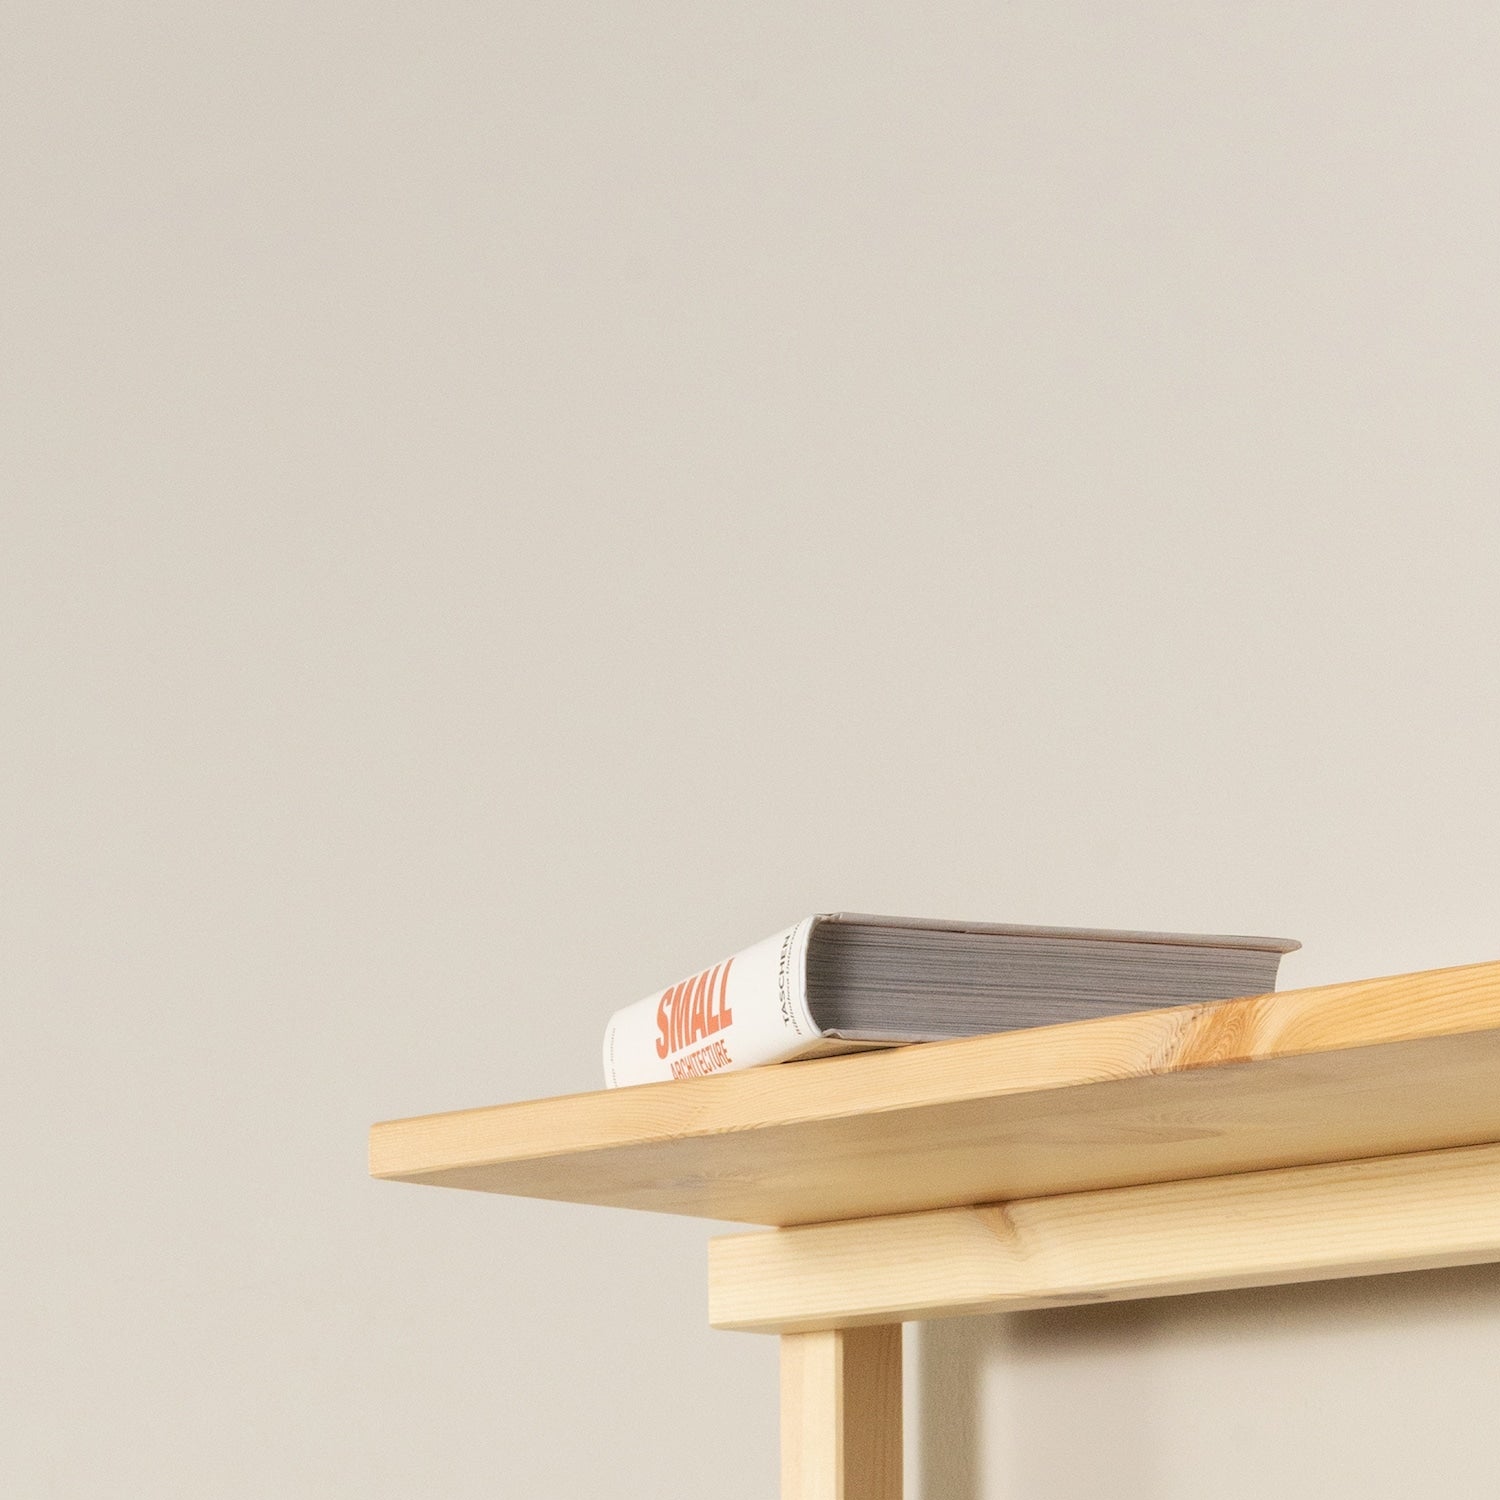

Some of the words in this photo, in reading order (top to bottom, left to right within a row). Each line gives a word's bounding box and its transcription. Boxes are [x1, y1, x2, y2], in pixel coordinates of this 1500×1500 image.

[655, 957, 735, 1060] SMALL
[779, 934, 790, 1027] TASCHEN
[670, 1038, 733, 1081] ARCHITECTURE
